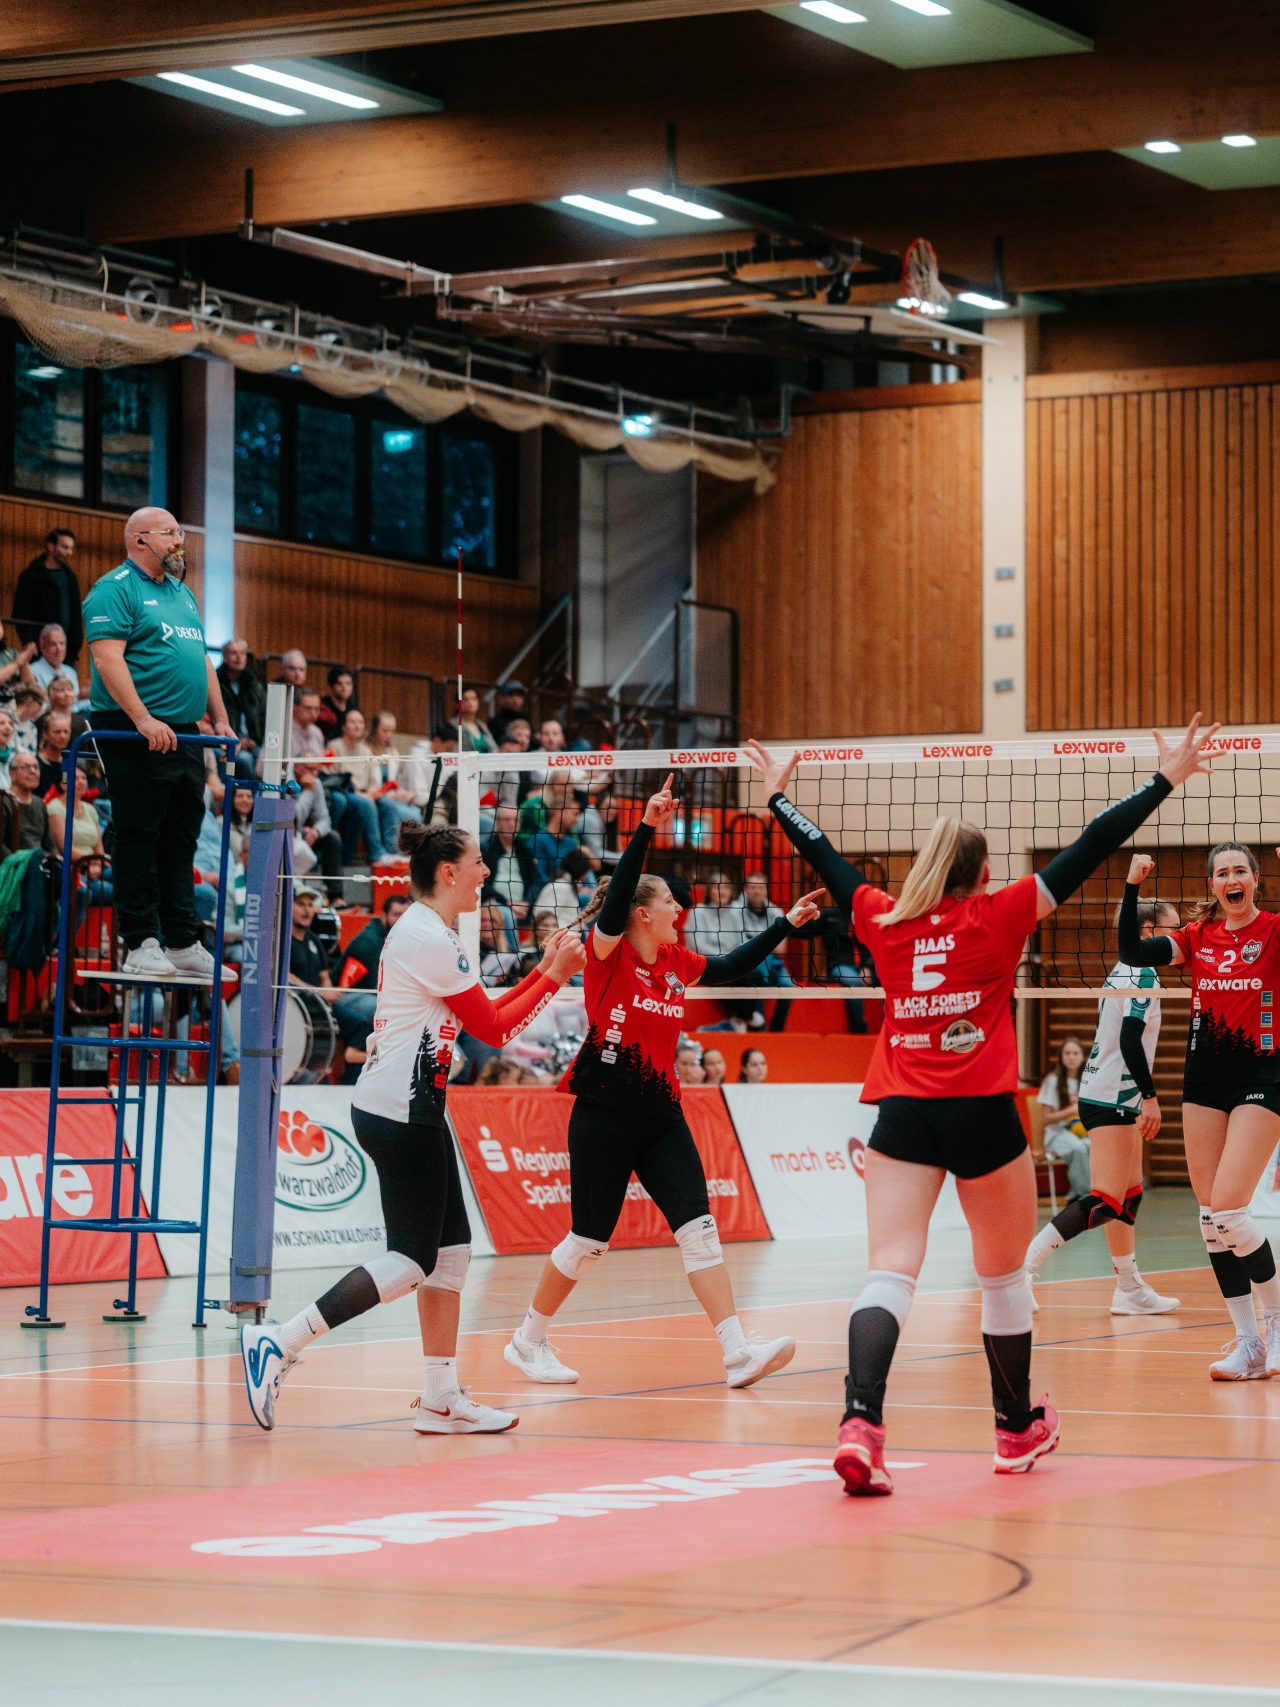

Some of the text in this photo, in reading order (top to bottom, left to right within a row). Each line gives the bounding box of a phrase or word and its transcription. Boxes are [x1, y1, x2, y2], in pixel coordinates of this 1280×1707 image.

[670, 751, 737, 765] Lexware
[922, 744, 993, 758] Lexware
[1054, 740, 1126, 755] Lexware
[548, 754, 613, 768] Lexware
[775, 797, 822, 840] Lexware
[914, 933, 956, 955] HAAS
[912, 953, 947, 991] 5
[1217, 950, 1237, 973] 2
[930, 990, 982, 1008] FOREST
[502, 991, 553, 1044] Lexware
[511, 1146, 571, 1177] Region
[825, 1150, 845, 1170] es
